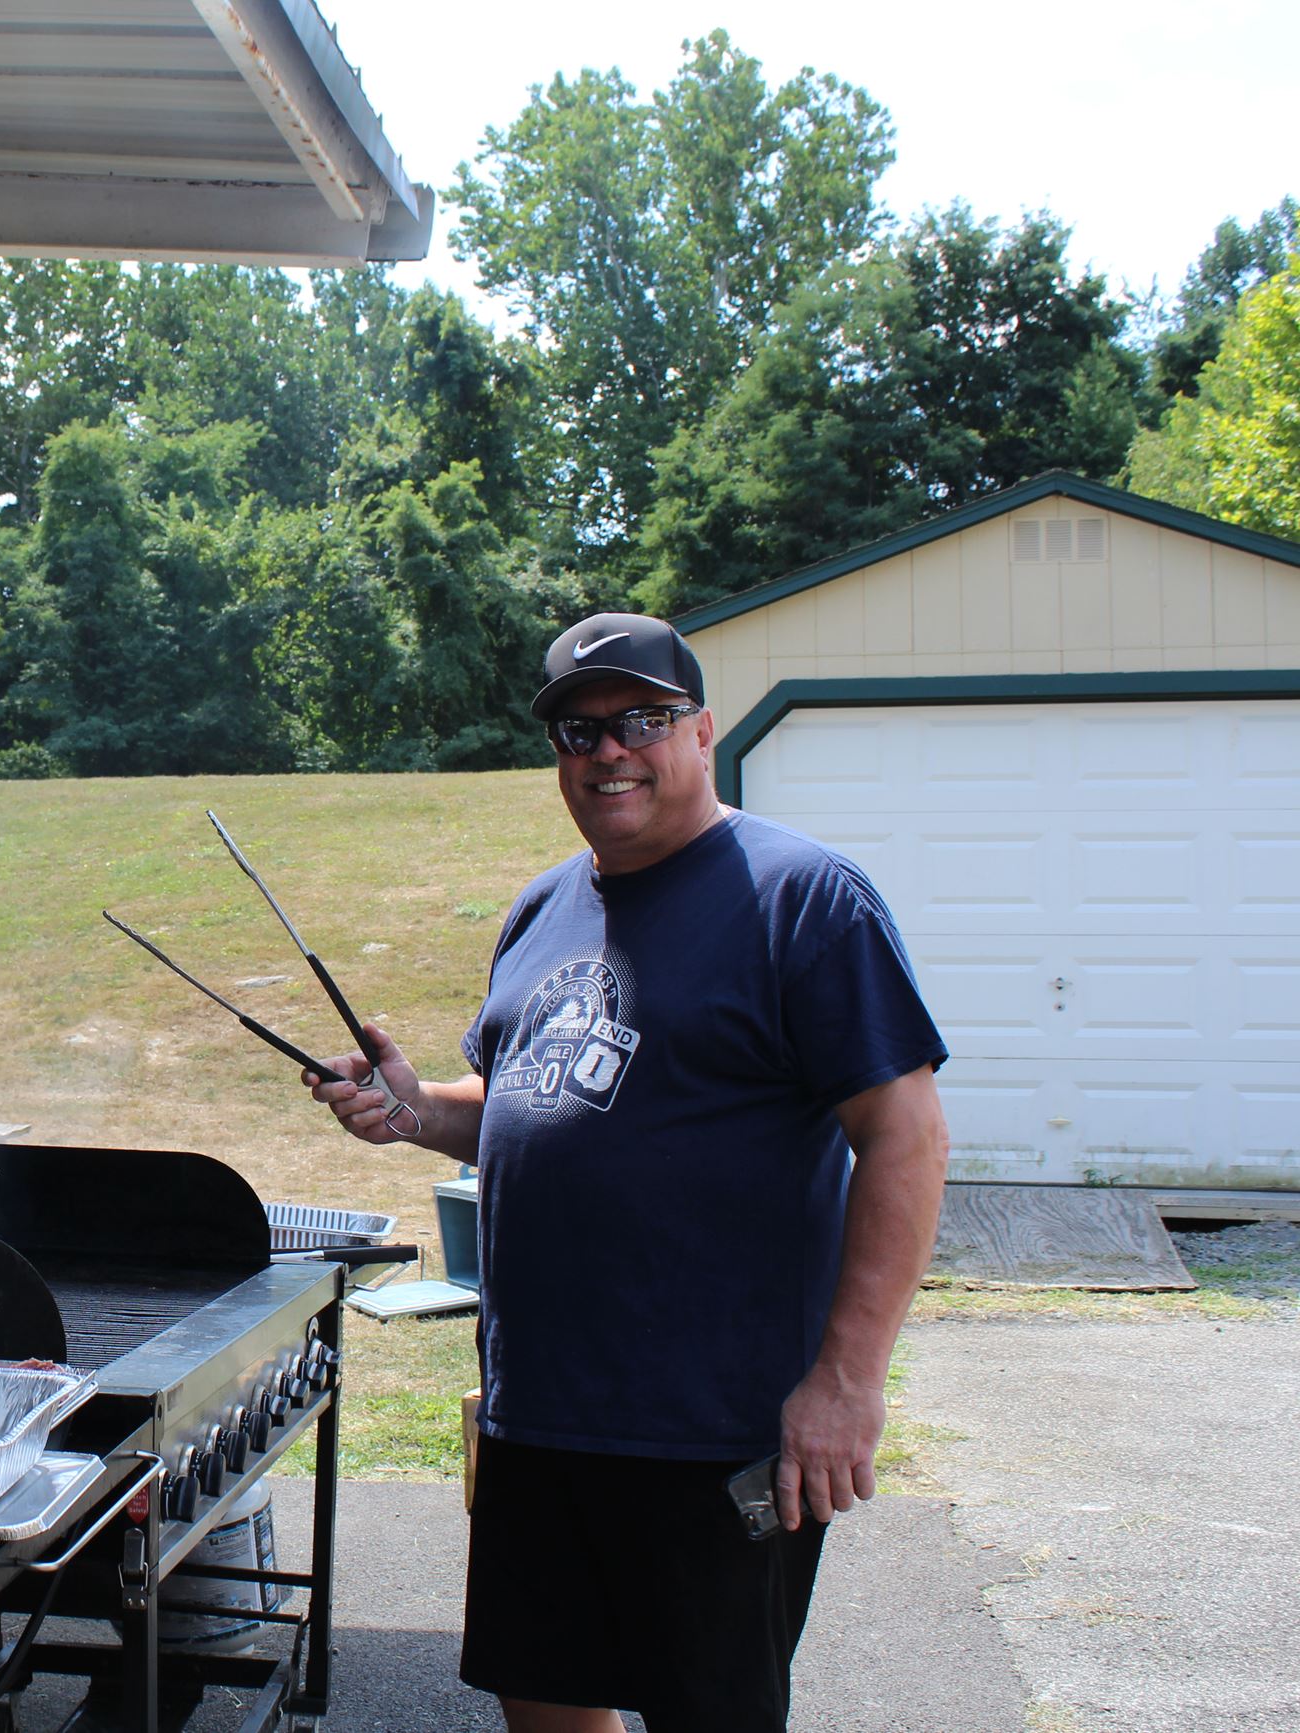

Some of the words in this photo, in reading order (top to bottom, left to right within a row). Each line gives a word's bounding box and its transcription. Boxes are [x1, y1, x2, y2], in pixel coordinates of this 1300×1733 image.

[538, 963, 576, 1000] KEY
[586, 963, 617, 1001] WEST
[542, 984, 579, 1013] FLORIDA
[598, 1022, 633, 1046] END
[546, 1047, 570, 1059] MILE
[587, 1054, 604, 1078] 1
[495, 1073, 522, 1092] DUVAL
